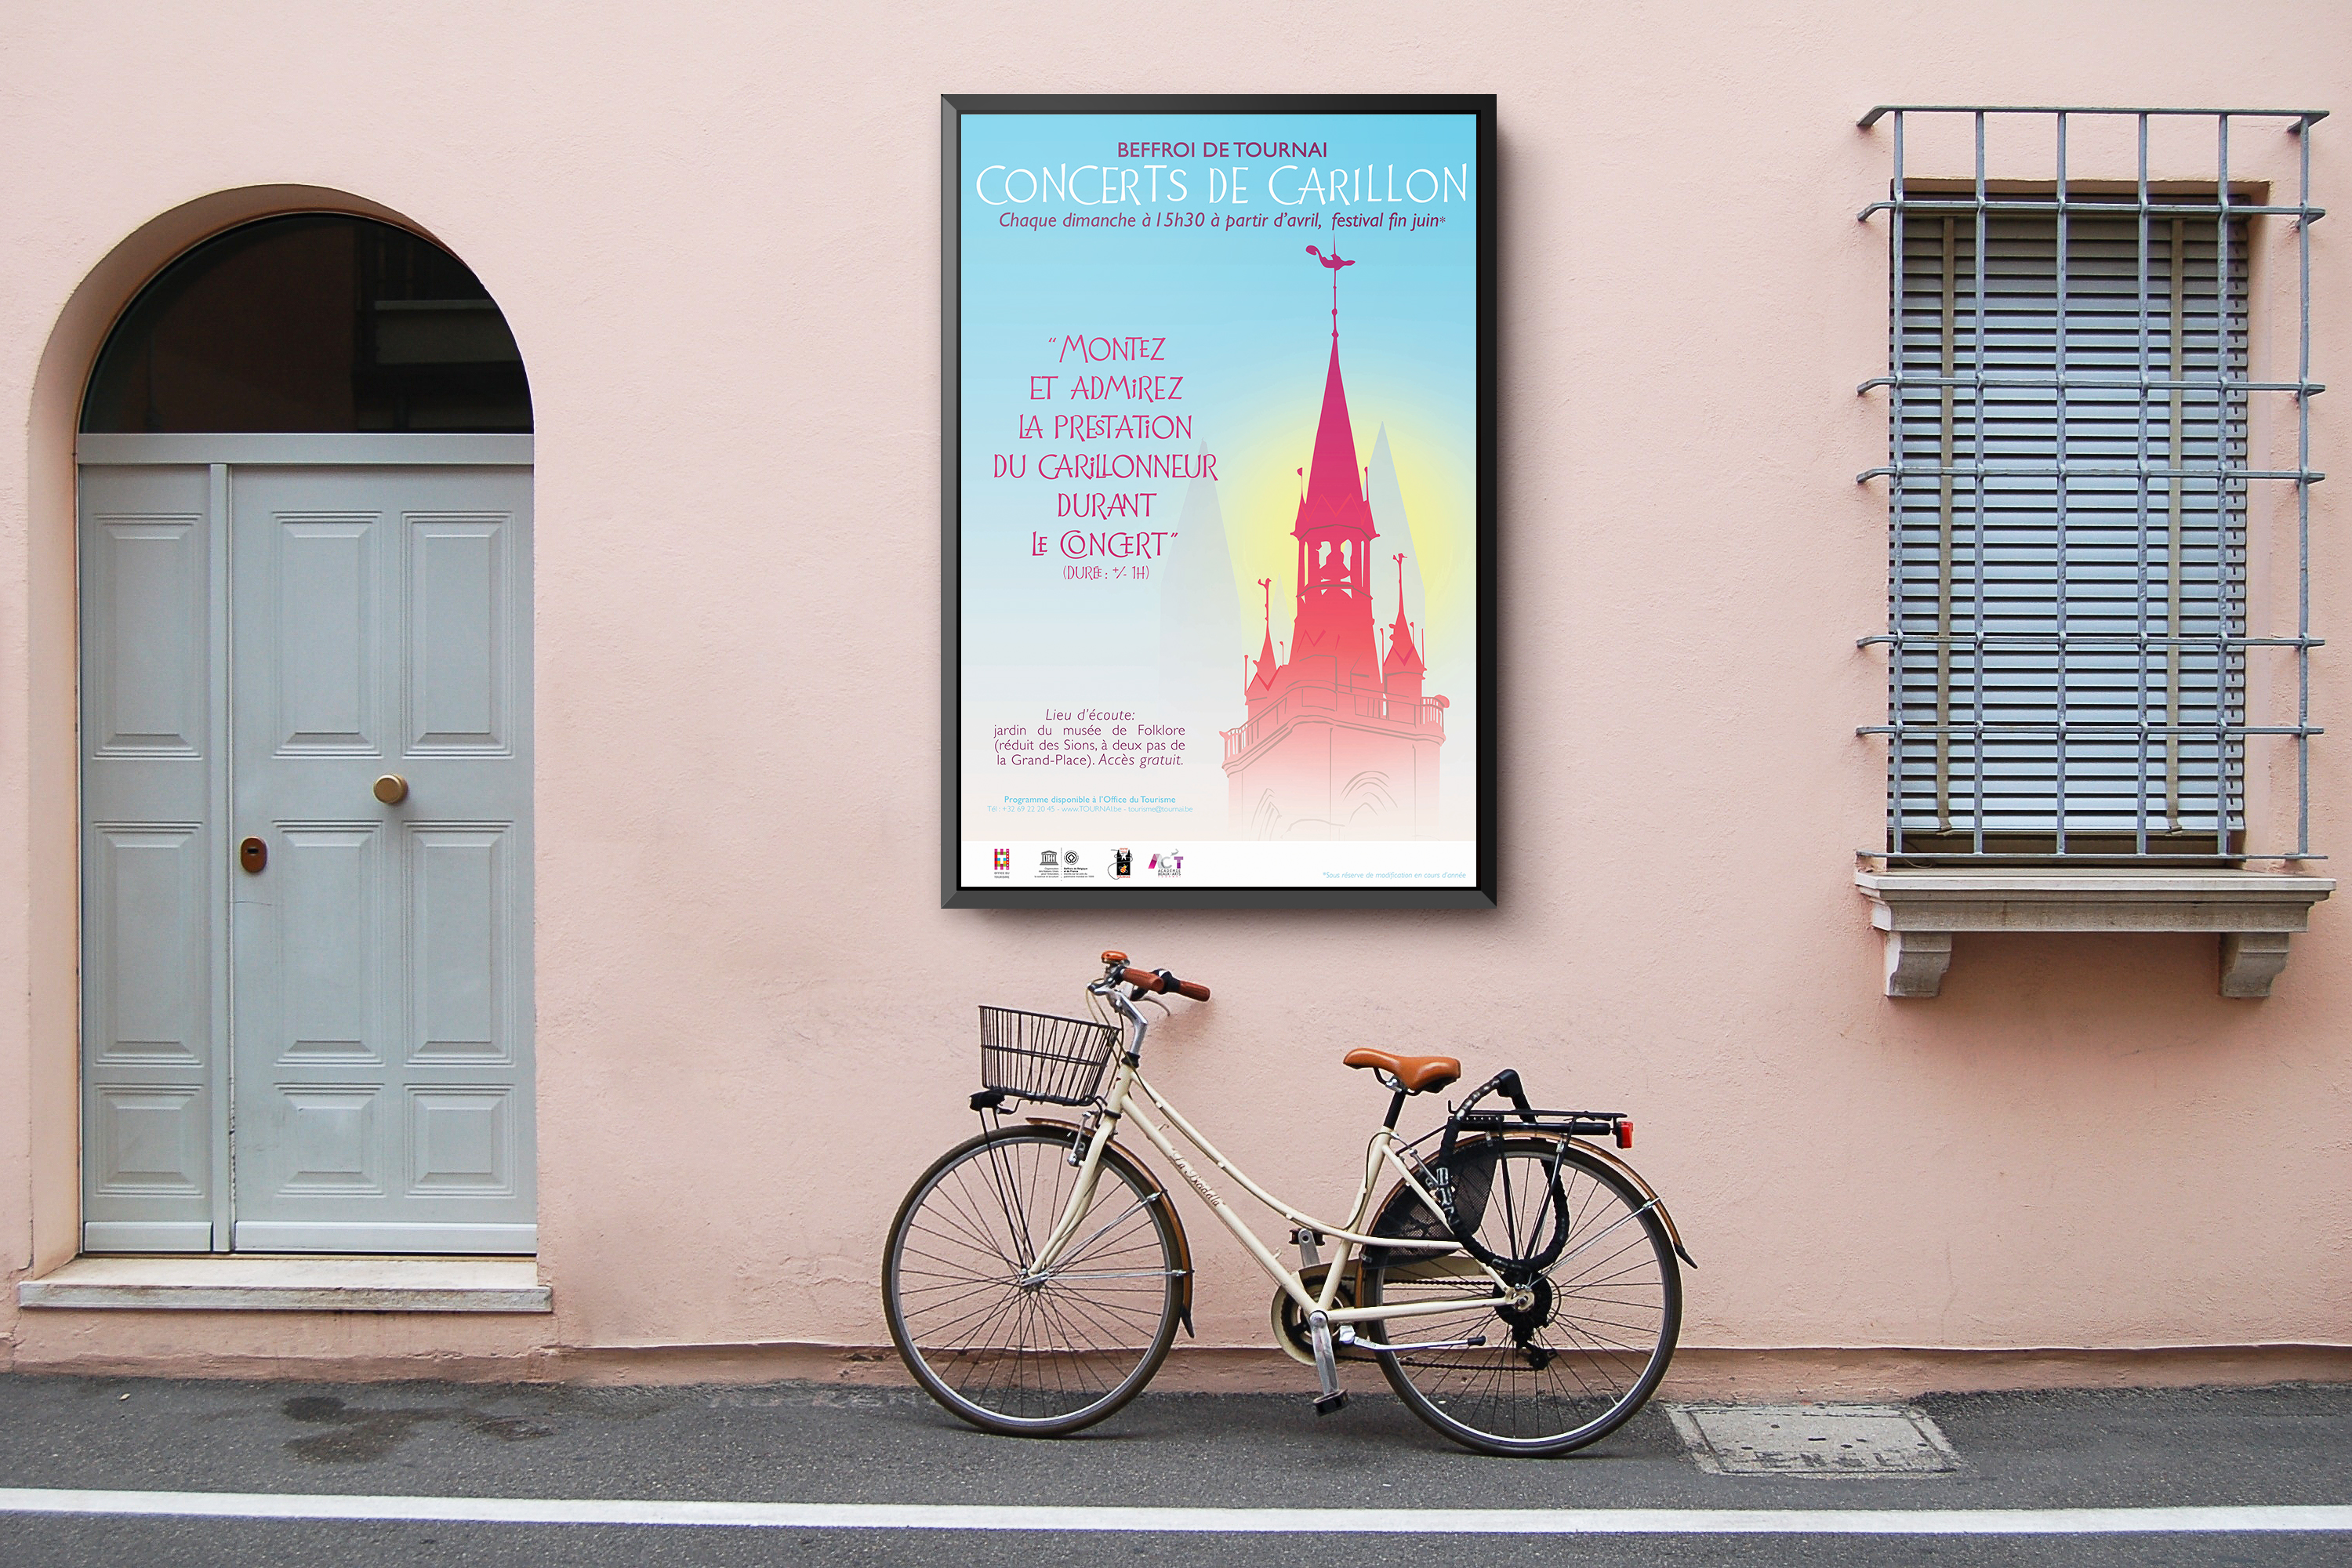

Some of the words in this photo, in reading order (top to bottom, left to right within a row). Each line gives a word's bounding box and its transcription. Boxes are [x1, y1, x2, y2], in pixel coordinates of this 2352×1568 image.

[1118, 141, 1195, 158] BEFFROI
[1203, 141, 1229, 158] DE
[1233, 141, 1327, 158] TOURNAI
[975, 162, 1188, 206] CONCERTS
[1208, 166, 1249, 205] DE
[1268, 162, 1467, 206] CARILLON
[999, 212, 1057, 232] Chaque
[1062, 212, 1136, 227] dimanche
[1142, 212, 1152, 227] à
[1156, 212, 1205, 227] 15h30
[1210, 212, 1220, 227] à
[1225, 212, 1269, 232] partir
[1273, 212, 1322, 230] d’avril,
[1331, 212, 1384, 231] festival
[1388, 212, 1407, 231] fin
[1030, 376, 1059, 400] ET
[1018, 413, 1044, 439] LA
[993, 453, 1026, 479] DU
[1058, 492, 1157, 521] DURANT
[1032, 531, 1048, 557] LE
[1045, 708, 1072, 721] Lieu
[1076, 708, 1135, 721] d’écoute:
[993, 724, 1026, 739] jardin
[1037, 724, 1052, 736] du
[1063, 724, 1102, 736] musée
[1112, 724, 1127, 736] de
[1138, 724, 1185, 736] Folklore
[994, 739, 1035, 753] (réduit
[1039, 739, 1059, 751] des
[1063, 739, 1098, 752] Sions,
[1101, 739, 1109, 752] à
[1112, 739, 1143, 752] deux
[1146, 742, 1167, 753] pas
[1171, 739, 1185, 751] de
[996, 754, 1007, 766] la
[1011, 753, 1095, 769] Grand-Place).
[1098, 753, 1135, 766] Accès
[1138, 753, 1184, 769] gratuit.
[1004, 795, 1049, 807] Programme
[1051, 795, 1091, 805] disponible
